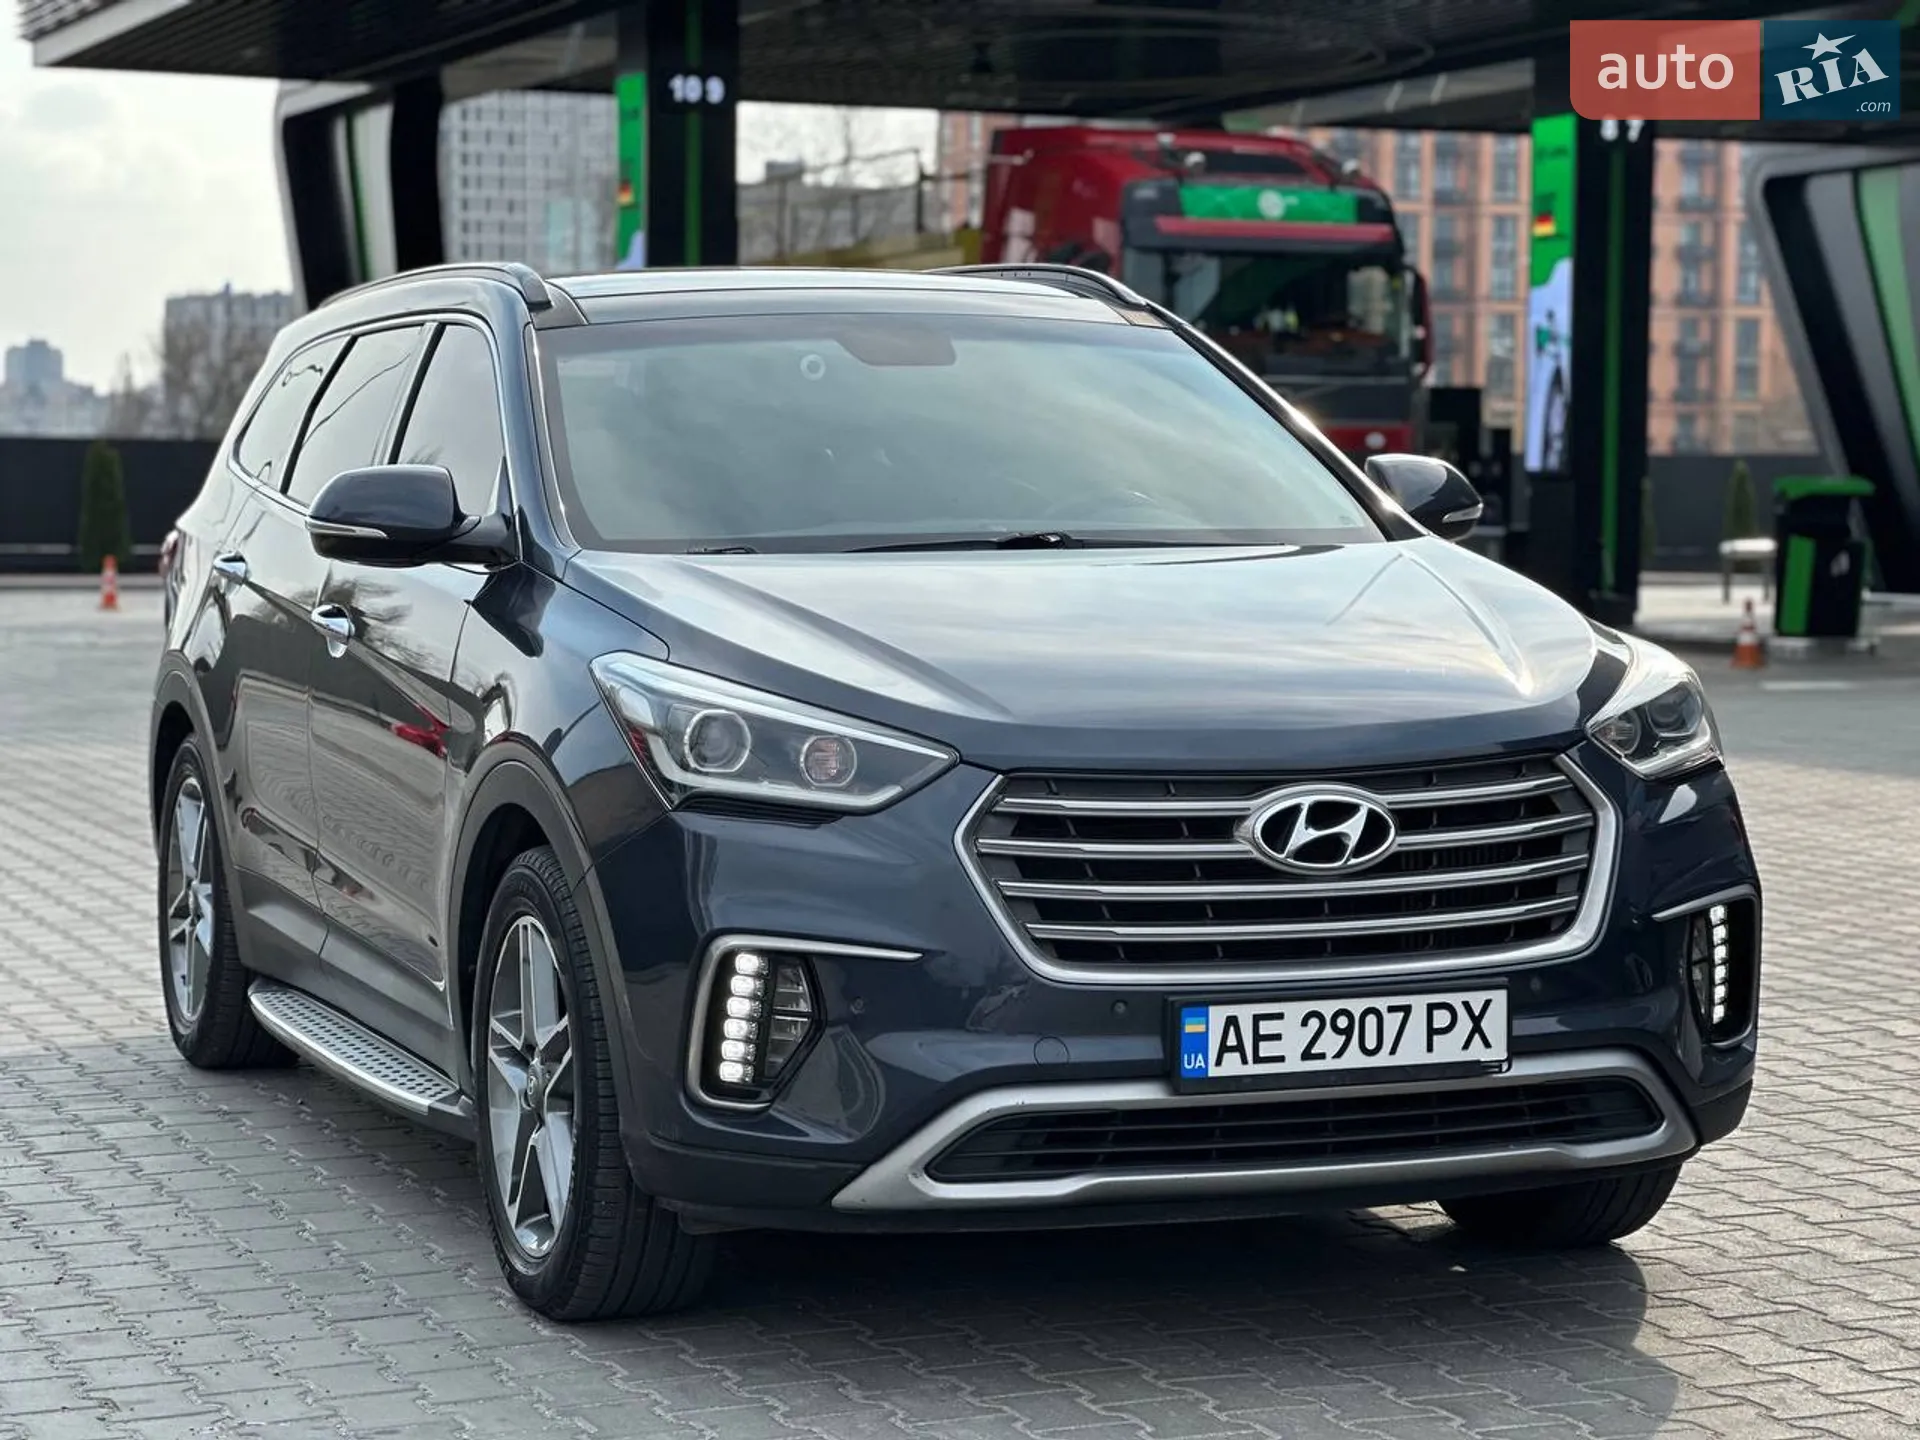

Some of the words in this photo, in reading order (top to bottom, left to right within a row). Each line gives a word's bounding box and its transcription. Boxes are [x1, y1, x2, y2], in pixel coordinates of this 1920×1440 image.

[1214, 1012, 1286, 1067] AE
[1300, 1004, 1413, 1062] 2907
[1426, 998, 1494, 1053] PX
[1183, 1053, 1206, 1070] UA
